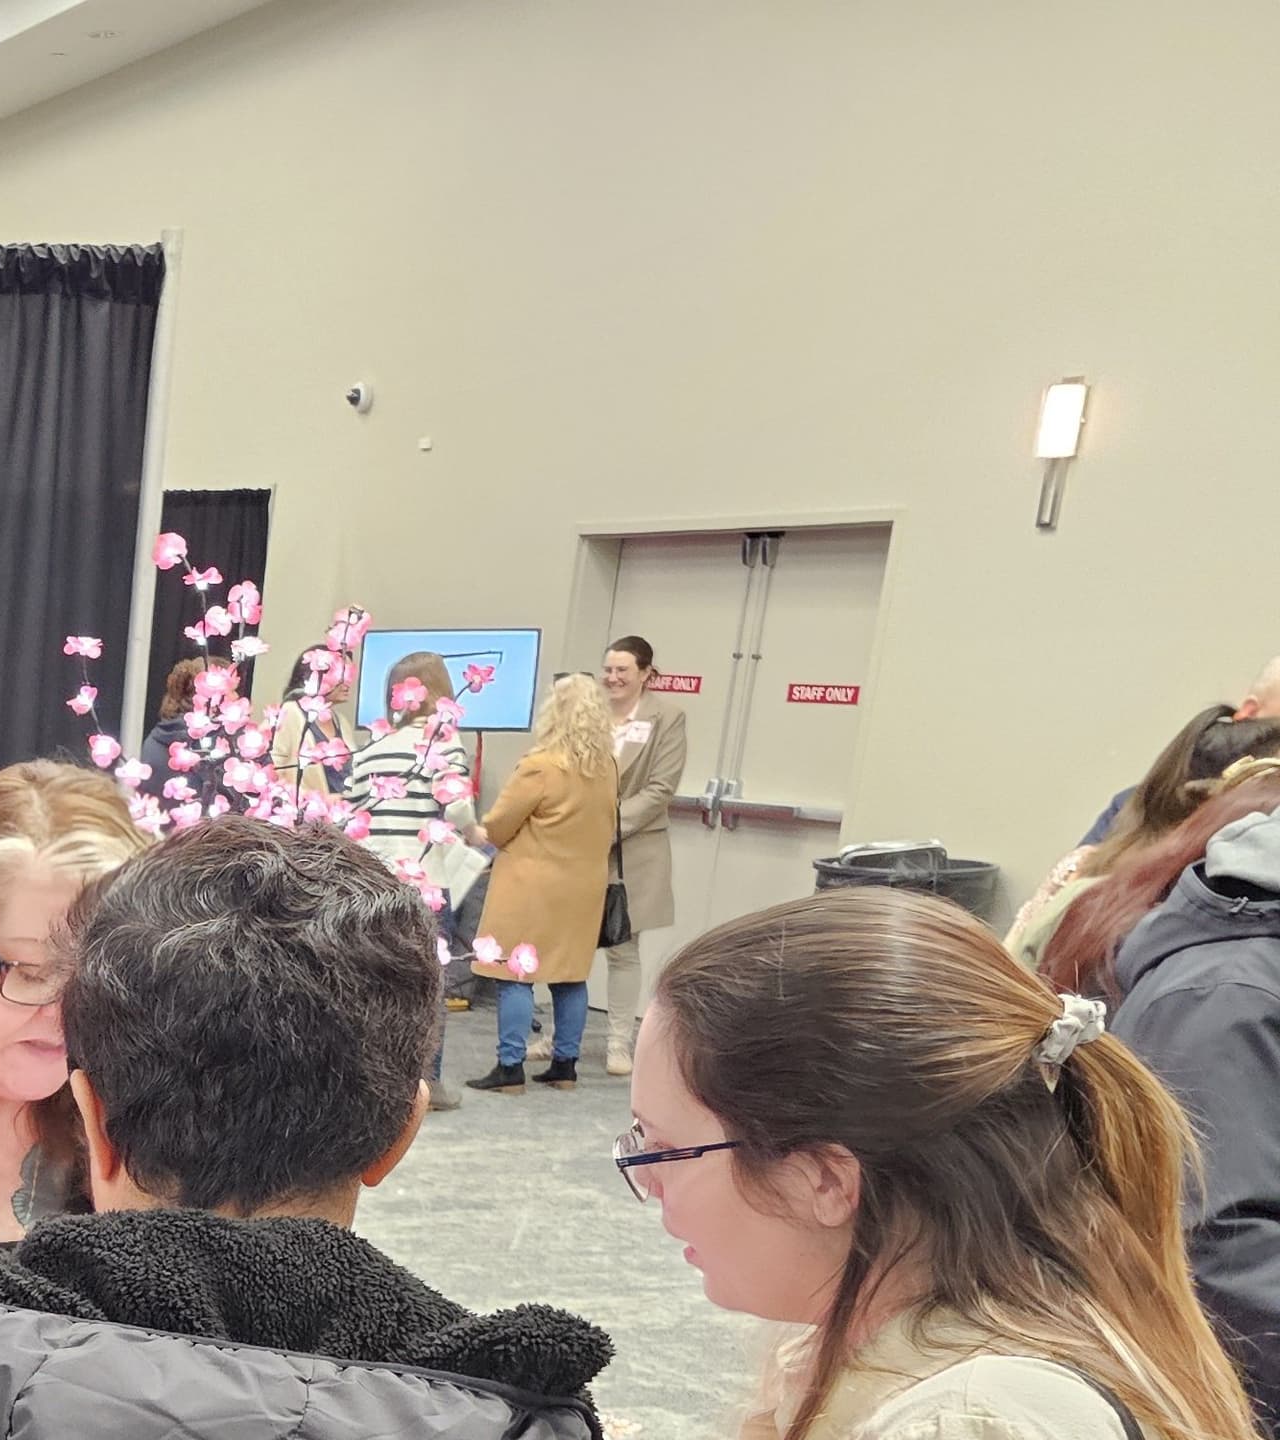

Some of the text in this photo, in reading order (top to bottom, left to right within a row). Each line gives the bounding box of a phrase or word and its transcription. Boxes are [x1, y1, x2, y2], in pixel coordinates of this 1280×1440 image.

[672, 677, 700, 691] ONLY
[791, 686, 855, 702] STAFF ONLY
